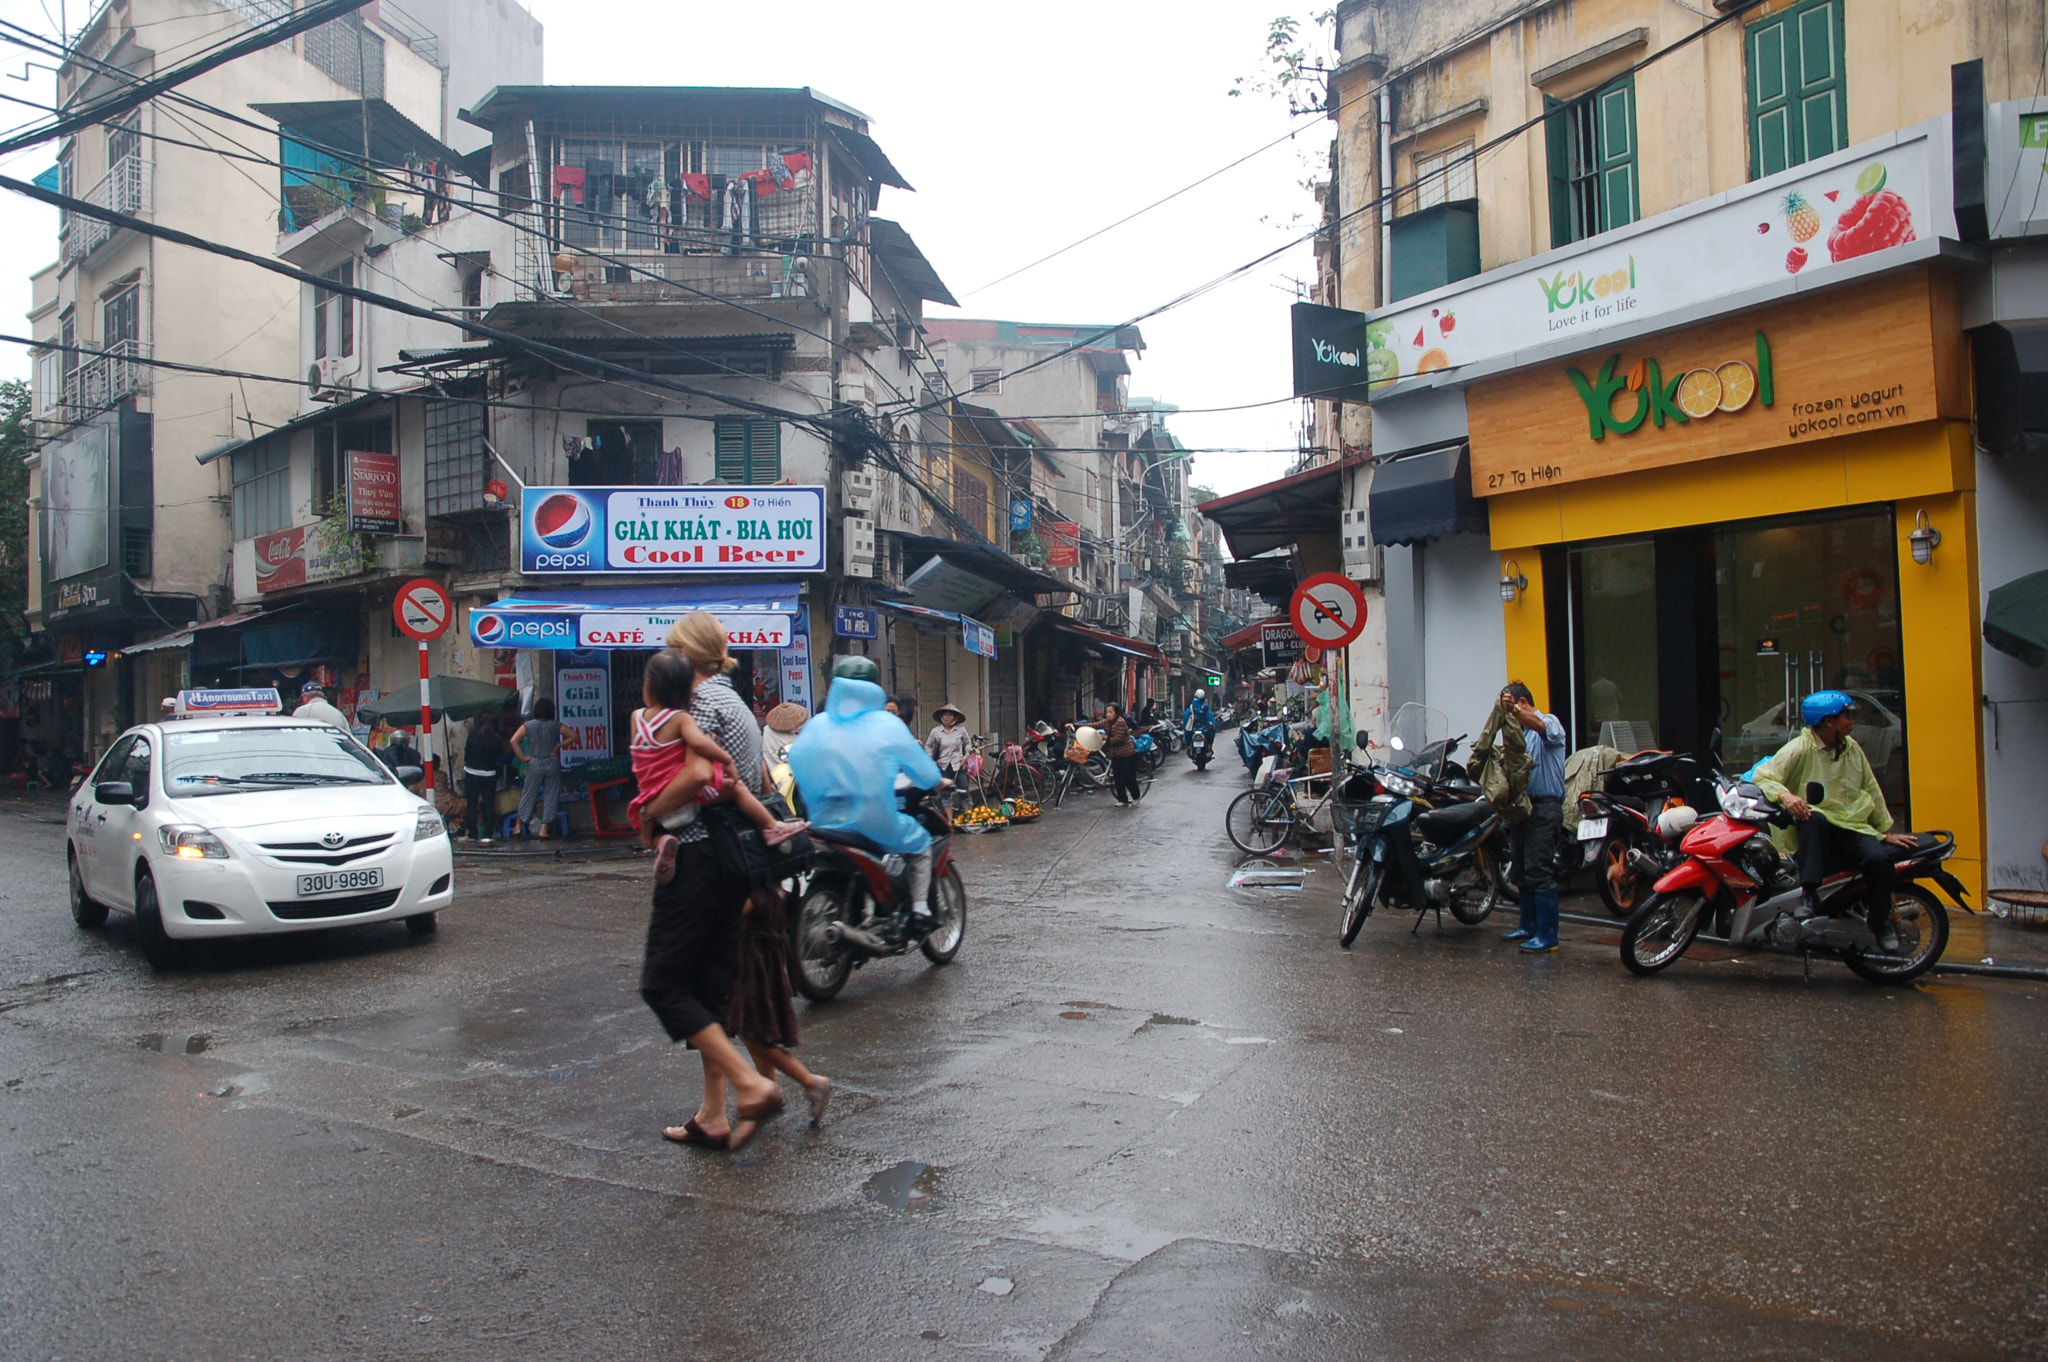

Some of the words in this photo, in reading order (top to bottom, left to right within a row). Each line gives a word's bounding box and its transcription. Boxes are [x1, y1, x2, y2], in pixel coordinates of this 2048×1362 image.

[1537, 253, 1635, 314] Yokool
[1548, 315, 1577, 331] Love
[1581, 310, 1589, 322] it
[1594, 305, 1612, 319] for
[1616, 296, 1637, 312] life
[1311, 337, 1360, 368] Yokool
[1564, 330, 1775, 440] Yokool
[1792, 397, 1844, 416] frozen
[1850, 383, 1903, 408] yogurt
[1488, 473, 1504, 488] 27
[1510, 470, 1526, 485] Tạ
[1531, 464, 1562, 480] Hiện
[637, 496, 679, 507] Thanh
[730, 497, 745, 507] 18
[753, 498, 765, 508] Tạ
[614, 512, 658, 541] GIẢI
[664, 515, 721, 541] KHÁT
[737, 520, 772, 541] BIA
[777, 517, 813, 541] HƠI
[535, 551, 591, 570] pepsi
[624, 545, 704, 564] Cool
[718, 545, 805, 563] Beer
[509, 618, 570, 639] pepsi
[588, 627, 645, 643] CAFÉ
[1270, 641, 1284, 650] BAR
[795, 655, 807, 665] Beer
[788, 669, 803, 681] Pepsi
[562, 704, 604, 718] Khát
[303, 870, 378, 892] 30U-9896
